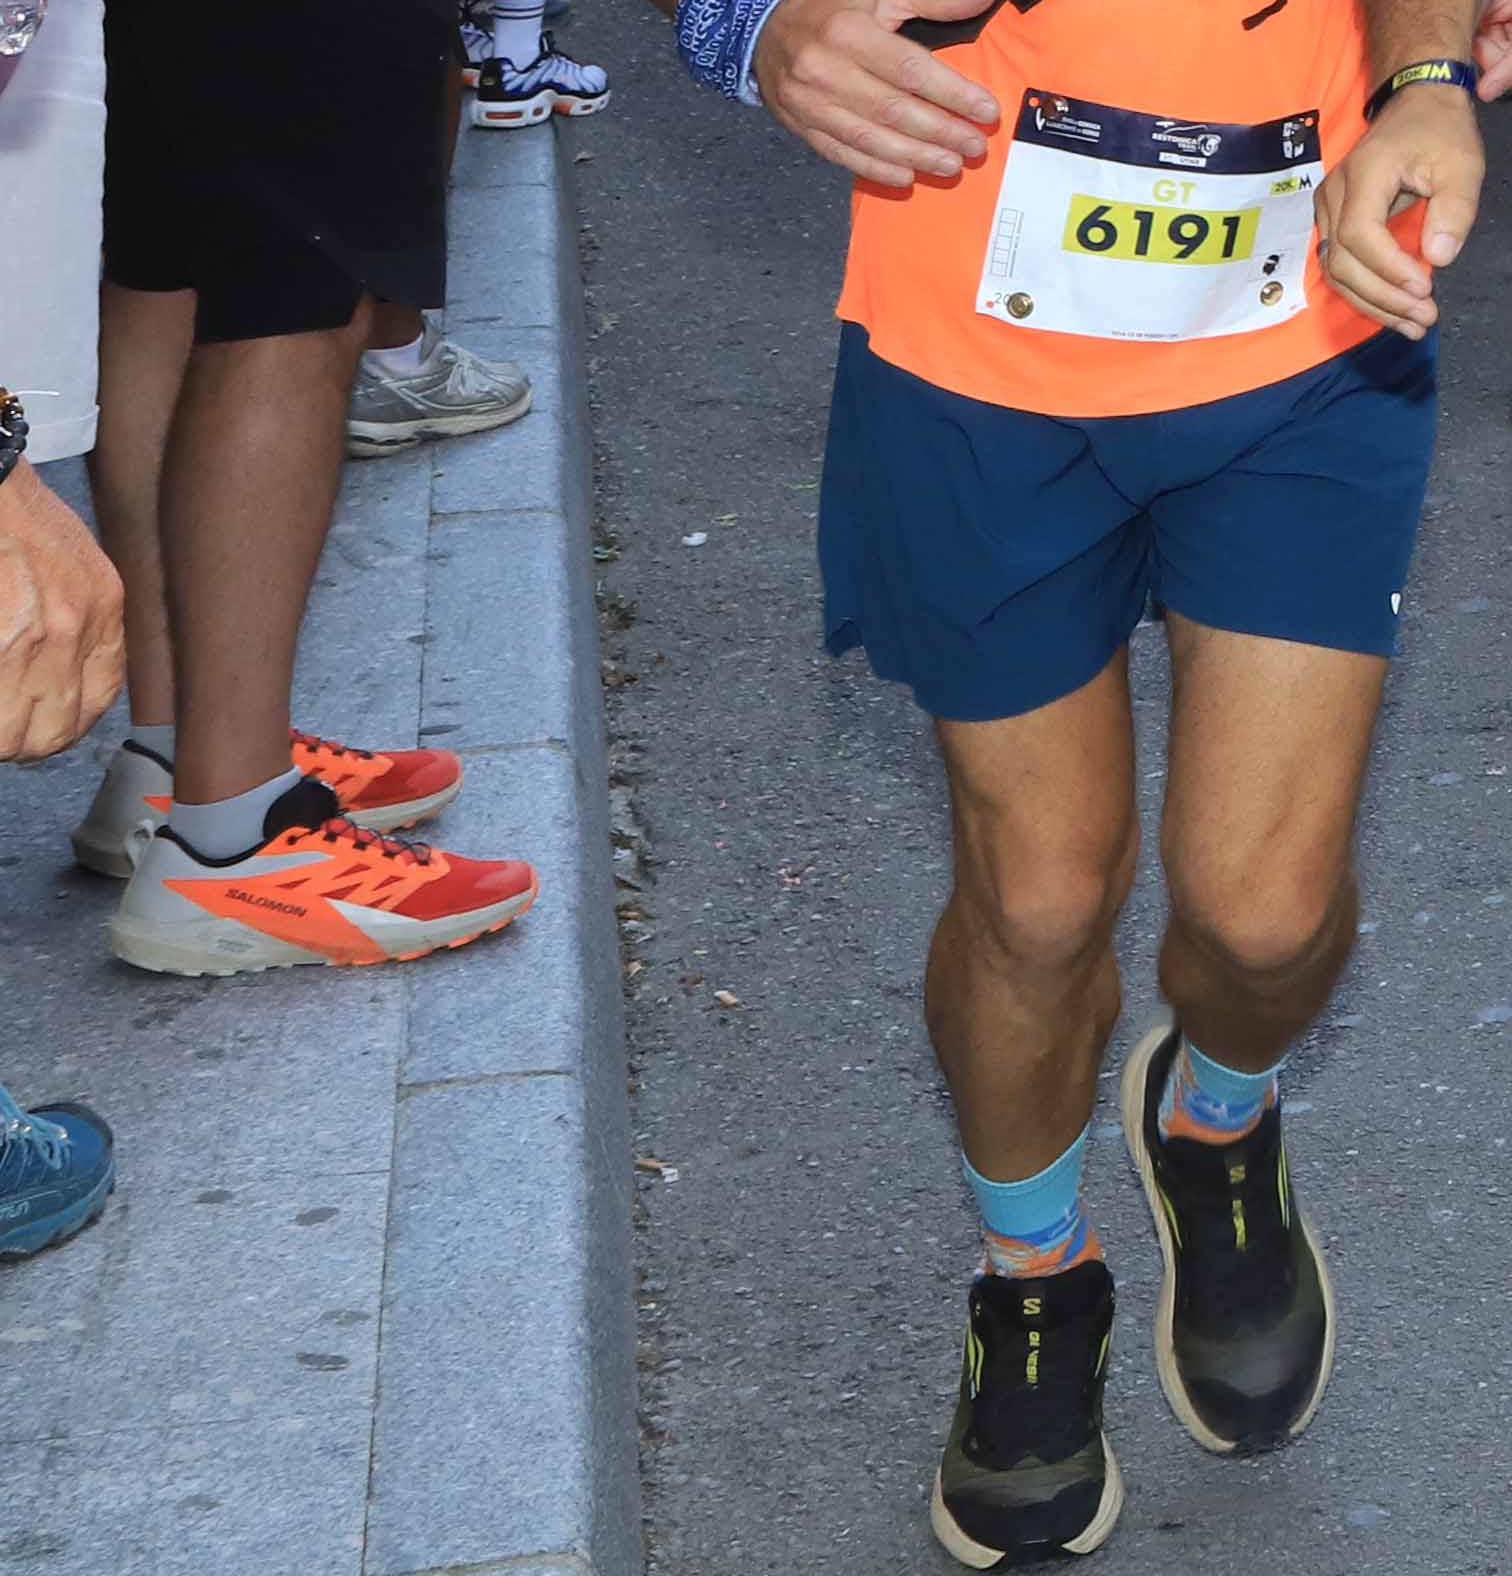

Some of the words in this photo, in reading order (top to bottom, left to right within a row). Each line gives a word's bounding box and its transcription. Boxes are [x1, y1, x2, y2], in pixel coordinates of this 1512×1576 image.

[1152, 178, 1197, 205] GT
[1076, 204, 1242, 260] 6191
[225, 887, 309, 917] SALOMON
